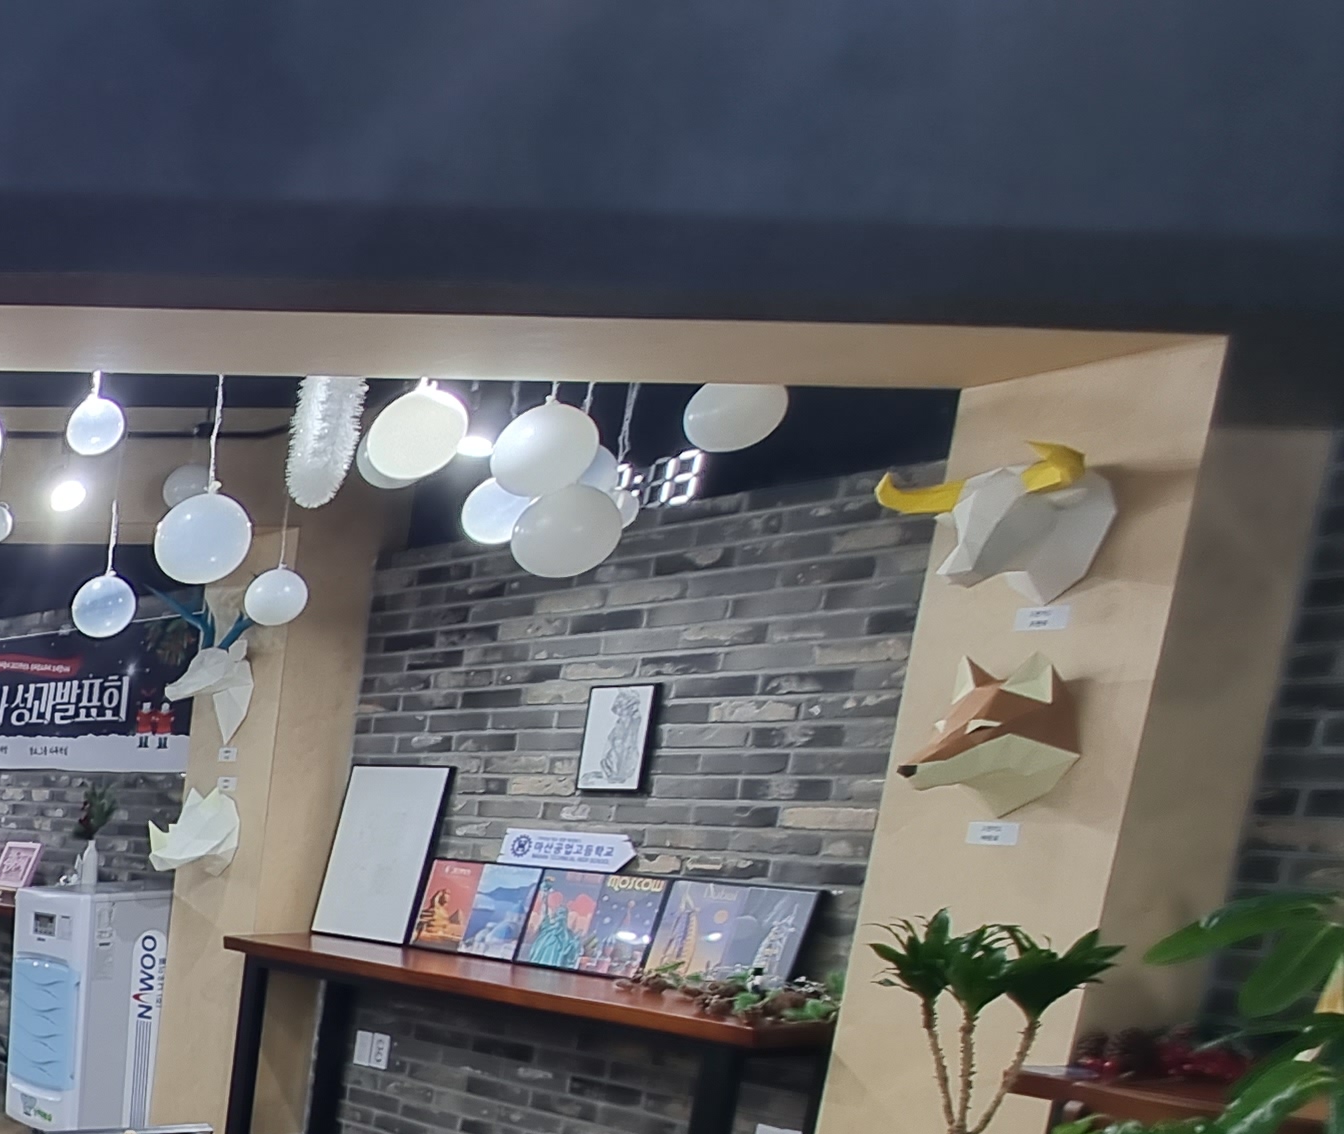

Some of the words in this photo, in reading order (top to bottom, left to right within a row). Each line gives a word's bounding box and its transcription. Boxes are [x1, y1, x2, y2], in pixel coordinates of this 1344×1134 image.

[11, 675, 130, 726] 성과발표회
[533, 841, 615, 857] 마산공업고등학교
[132, 934, 157, 1019] NAWOO
